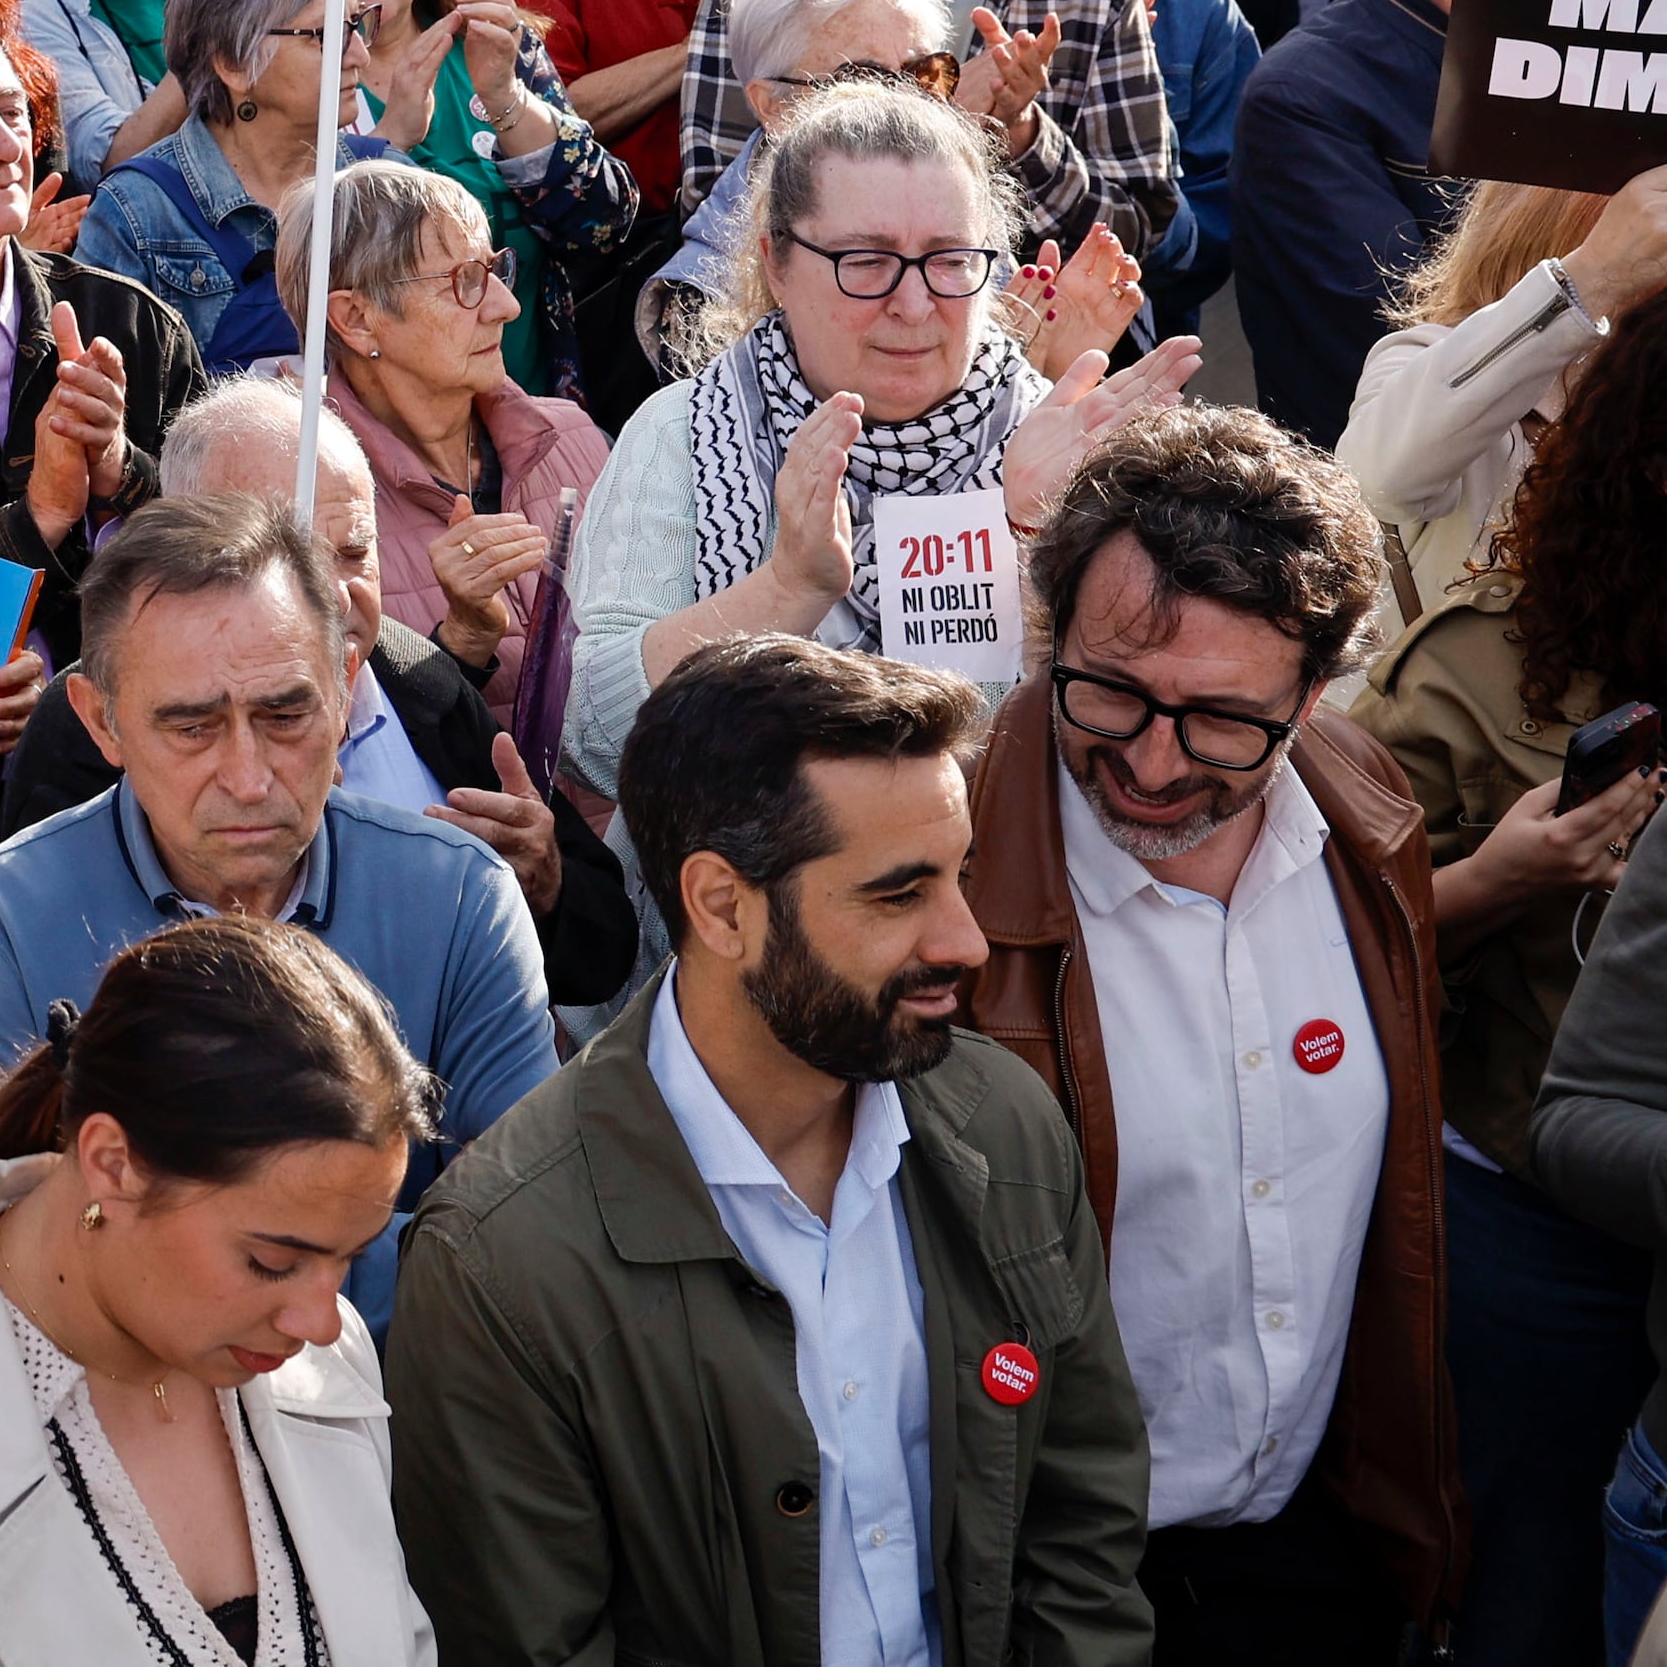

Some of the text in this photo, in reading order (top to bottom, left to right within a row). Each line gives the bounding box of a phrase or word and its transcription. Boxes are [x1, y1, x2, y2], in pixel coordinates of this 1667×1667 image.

[899, 528, 993, 579] 20:11
[901, 583, 994, 614] NI OBLIT
[904, 612, 999, 646] NI PERDÓ
[1300, 1031, 1339, 1053] Volem
[1305, 1043, 1340, 1063] votar.
[991, 1368, 1027, 1394] votar.
[995, 1352, 1035, 1383] Volem
